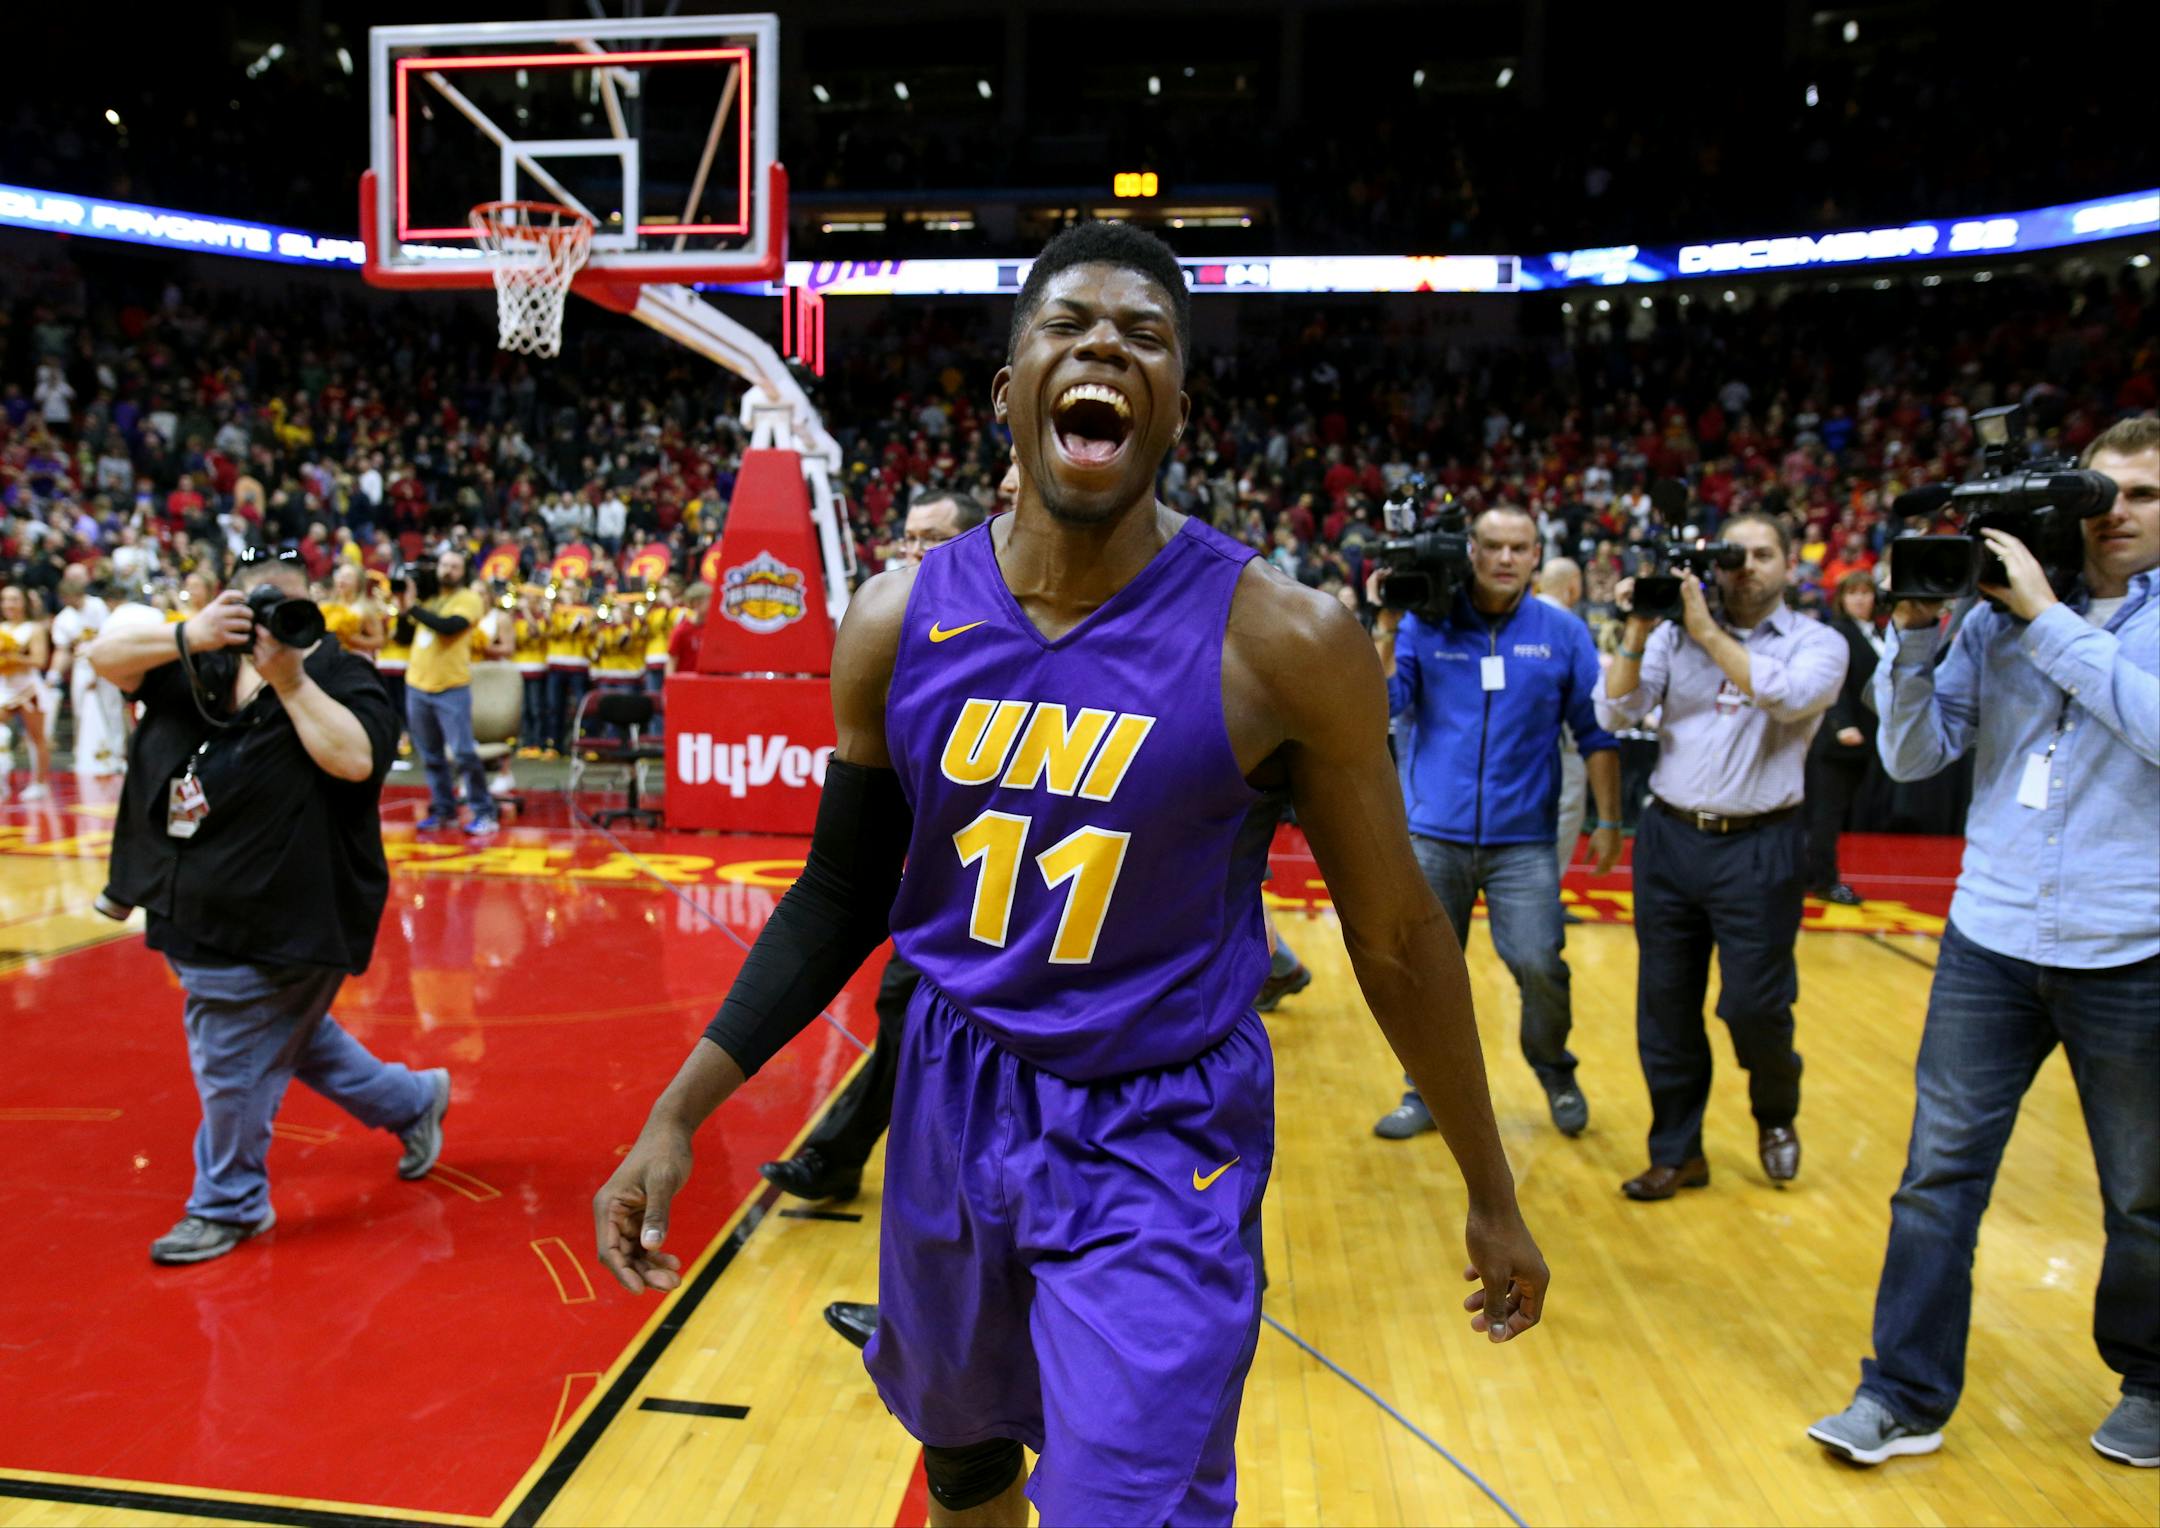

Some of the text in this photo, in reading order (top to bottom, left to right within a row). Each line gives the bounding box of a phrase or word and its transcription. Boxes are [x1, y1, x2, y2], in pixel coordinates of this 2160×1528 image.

[91, 204, 272, 252] FAVORITE
[1677, 225, 1939, 274] DECEMBER
[1947, 218, 2020, 252] 22
[940, 698, 1157, 802] UNI
[952, 809, 1132, 965] 11
